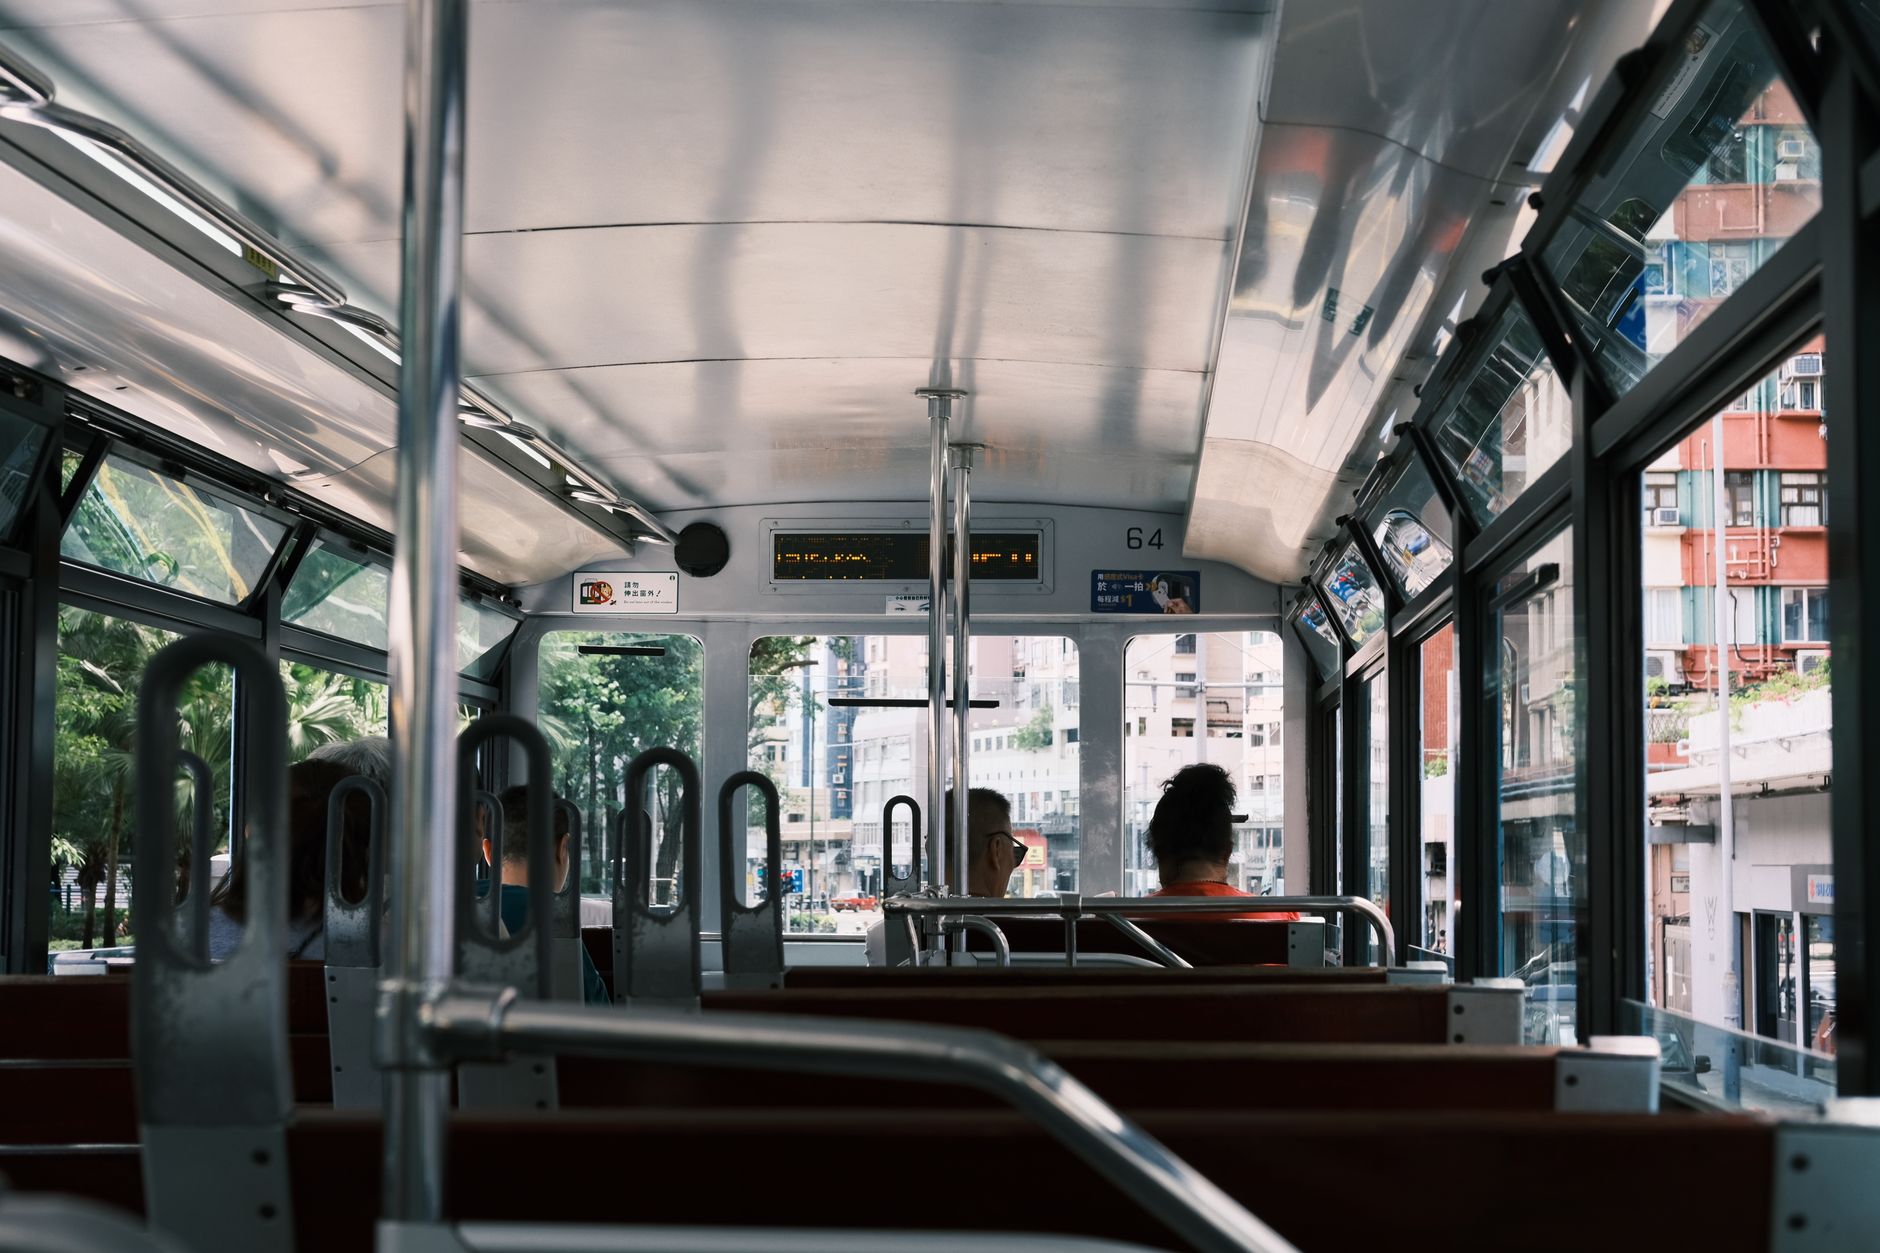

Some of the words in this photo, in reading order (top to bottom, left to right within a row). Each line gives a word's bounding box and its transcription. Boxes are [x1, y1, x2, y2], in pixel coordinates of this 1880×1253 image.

[1127, 527, 1164, 550] 64
[1097, 581, 1107, 591] 於
[1124, 581, 1144, 591] 一拍
